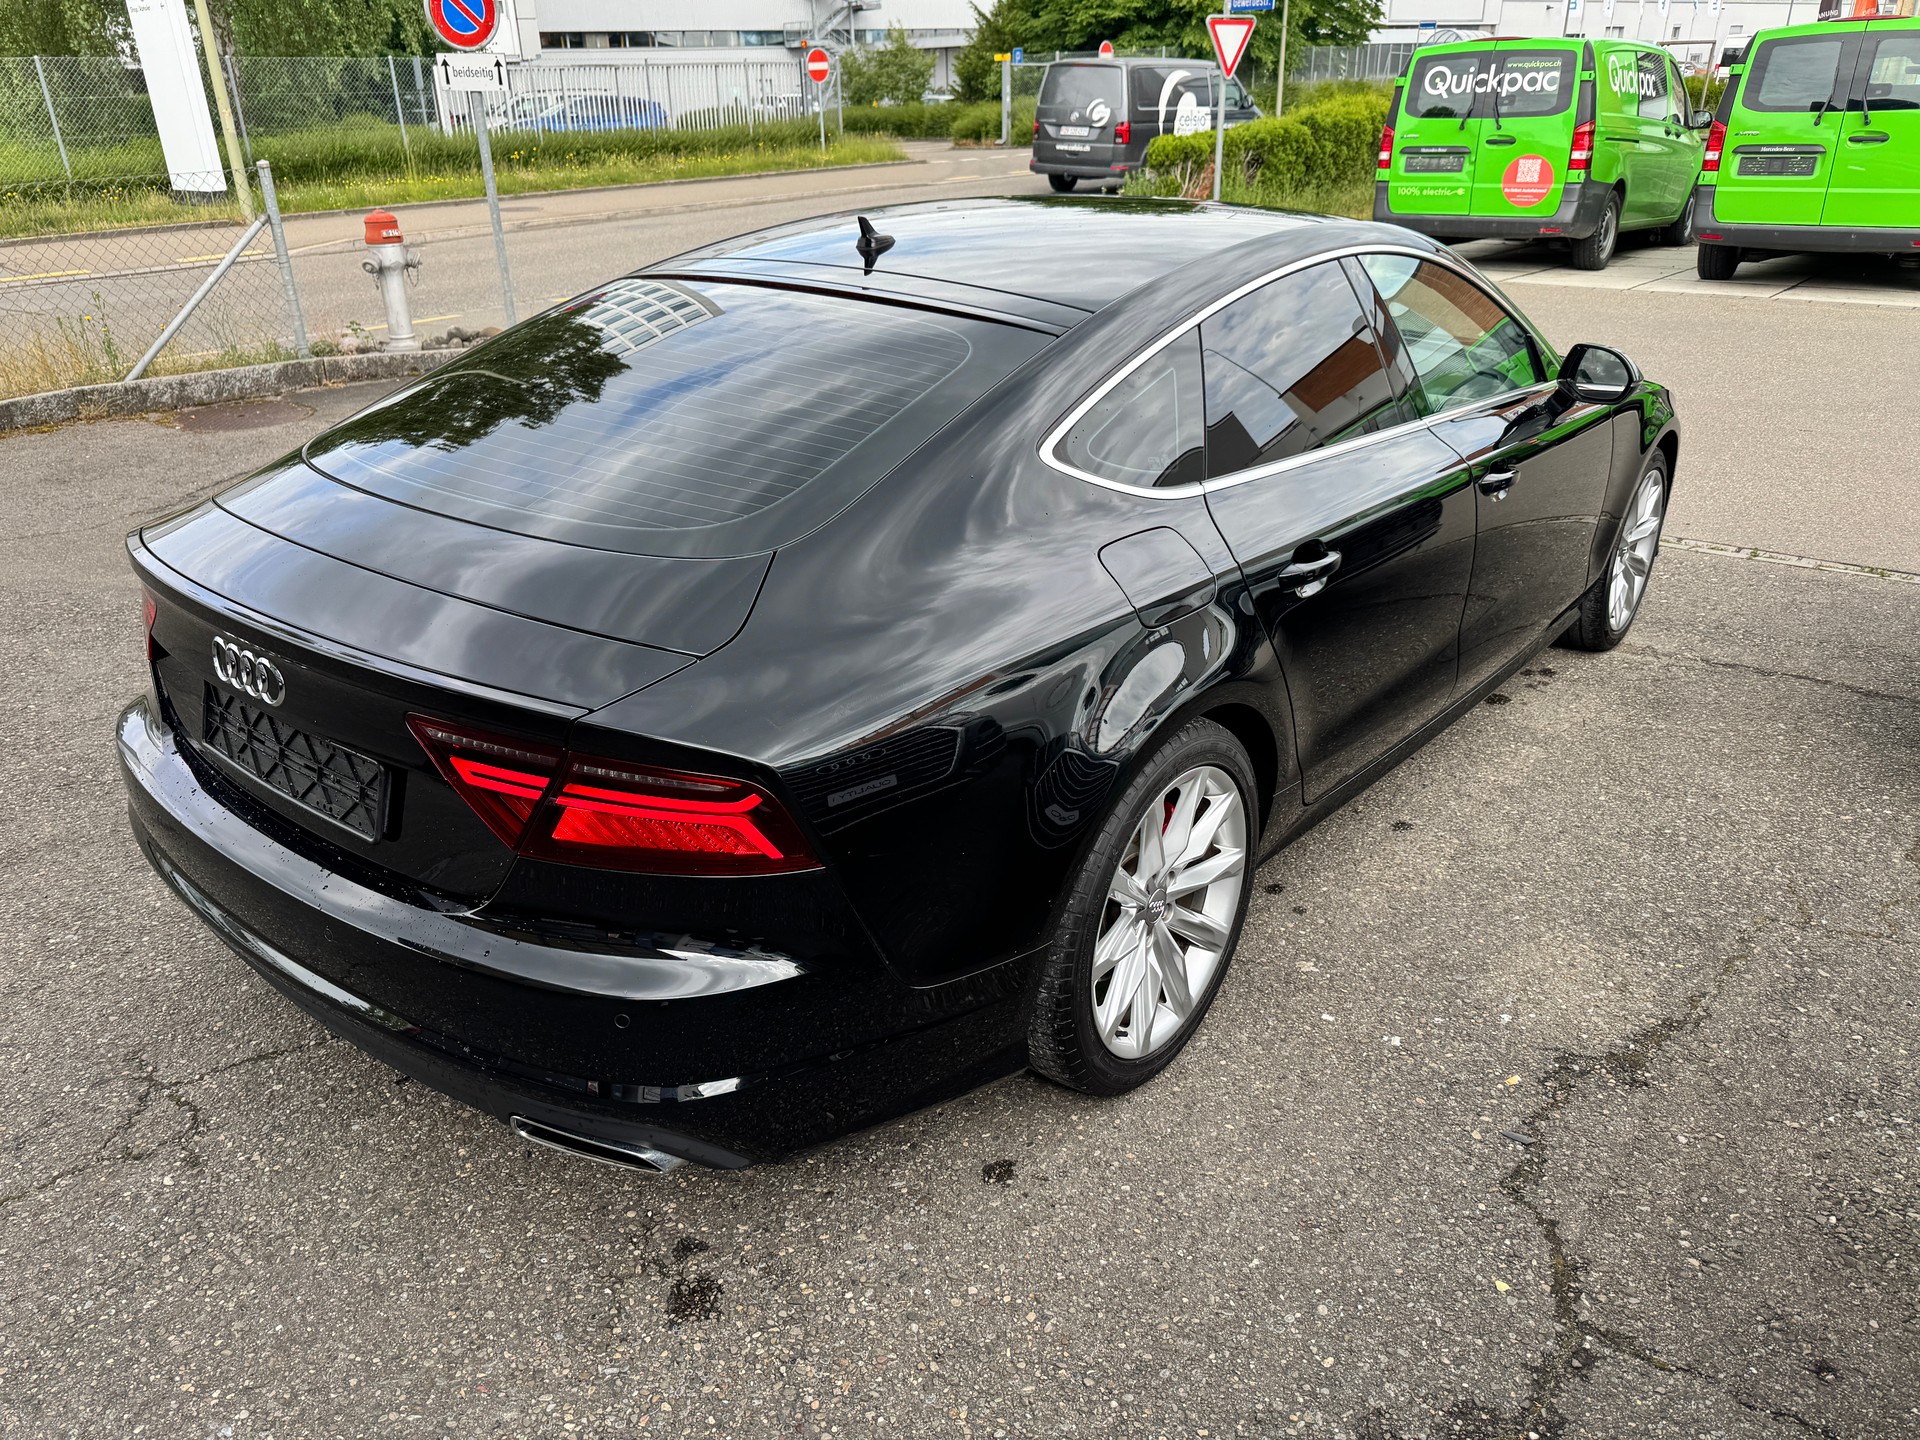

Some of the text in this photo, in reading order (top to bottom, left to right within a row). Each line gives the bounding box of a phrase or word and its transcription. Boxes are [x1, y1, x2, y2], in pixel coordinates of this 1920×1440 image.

[1507, 60, 1562, 69] www.quickpac.ch
[452, 66, 494, 81] beidseitig
[1424, 63, 1560, 99] Quickpac
[1608, 54, 1656, 101] Quickpac
[1179, 109, 1206, 127] celsio
[1397, 187, 1453, 197] 100% electric
